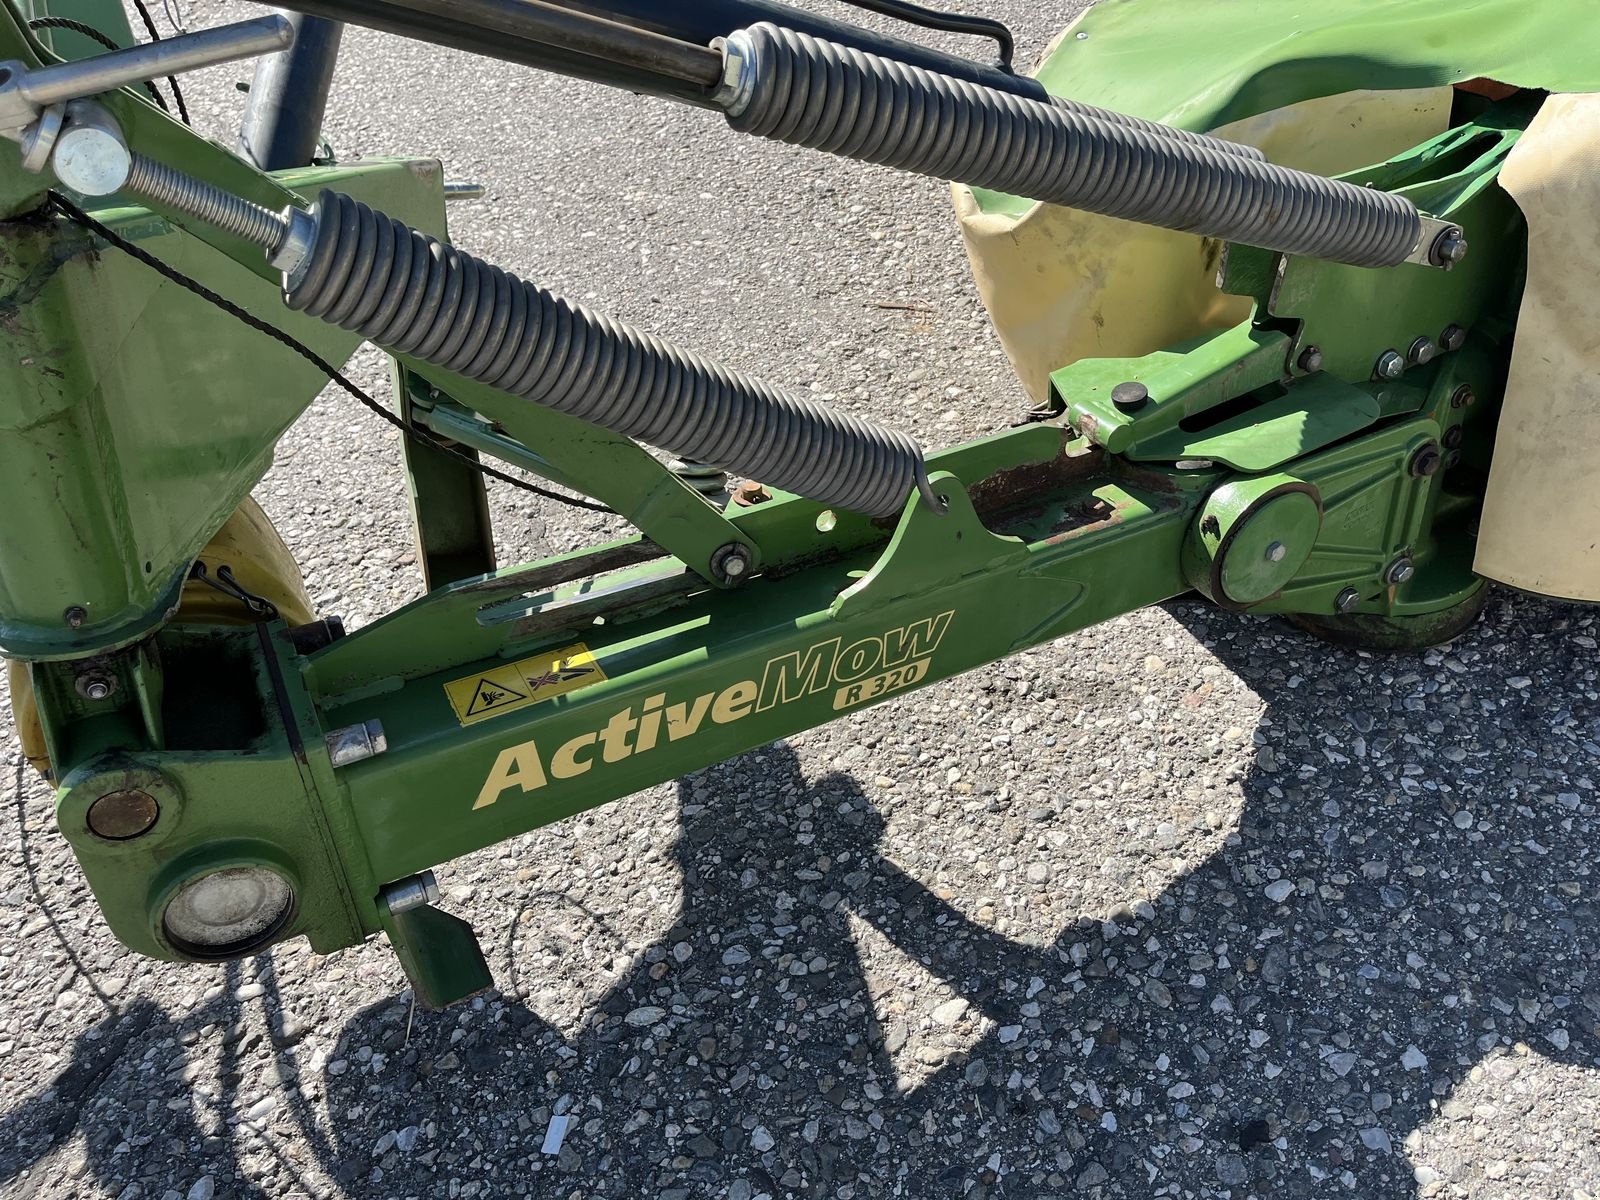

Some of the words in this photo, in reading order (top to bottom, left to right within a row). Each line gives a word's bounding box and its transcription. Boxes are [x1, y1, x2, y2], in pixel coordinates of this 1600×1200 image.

[472, 610, 956, 811] ActiveMow
[844, 685, 863, 706] R
[870, 665, 918, 696] 320
